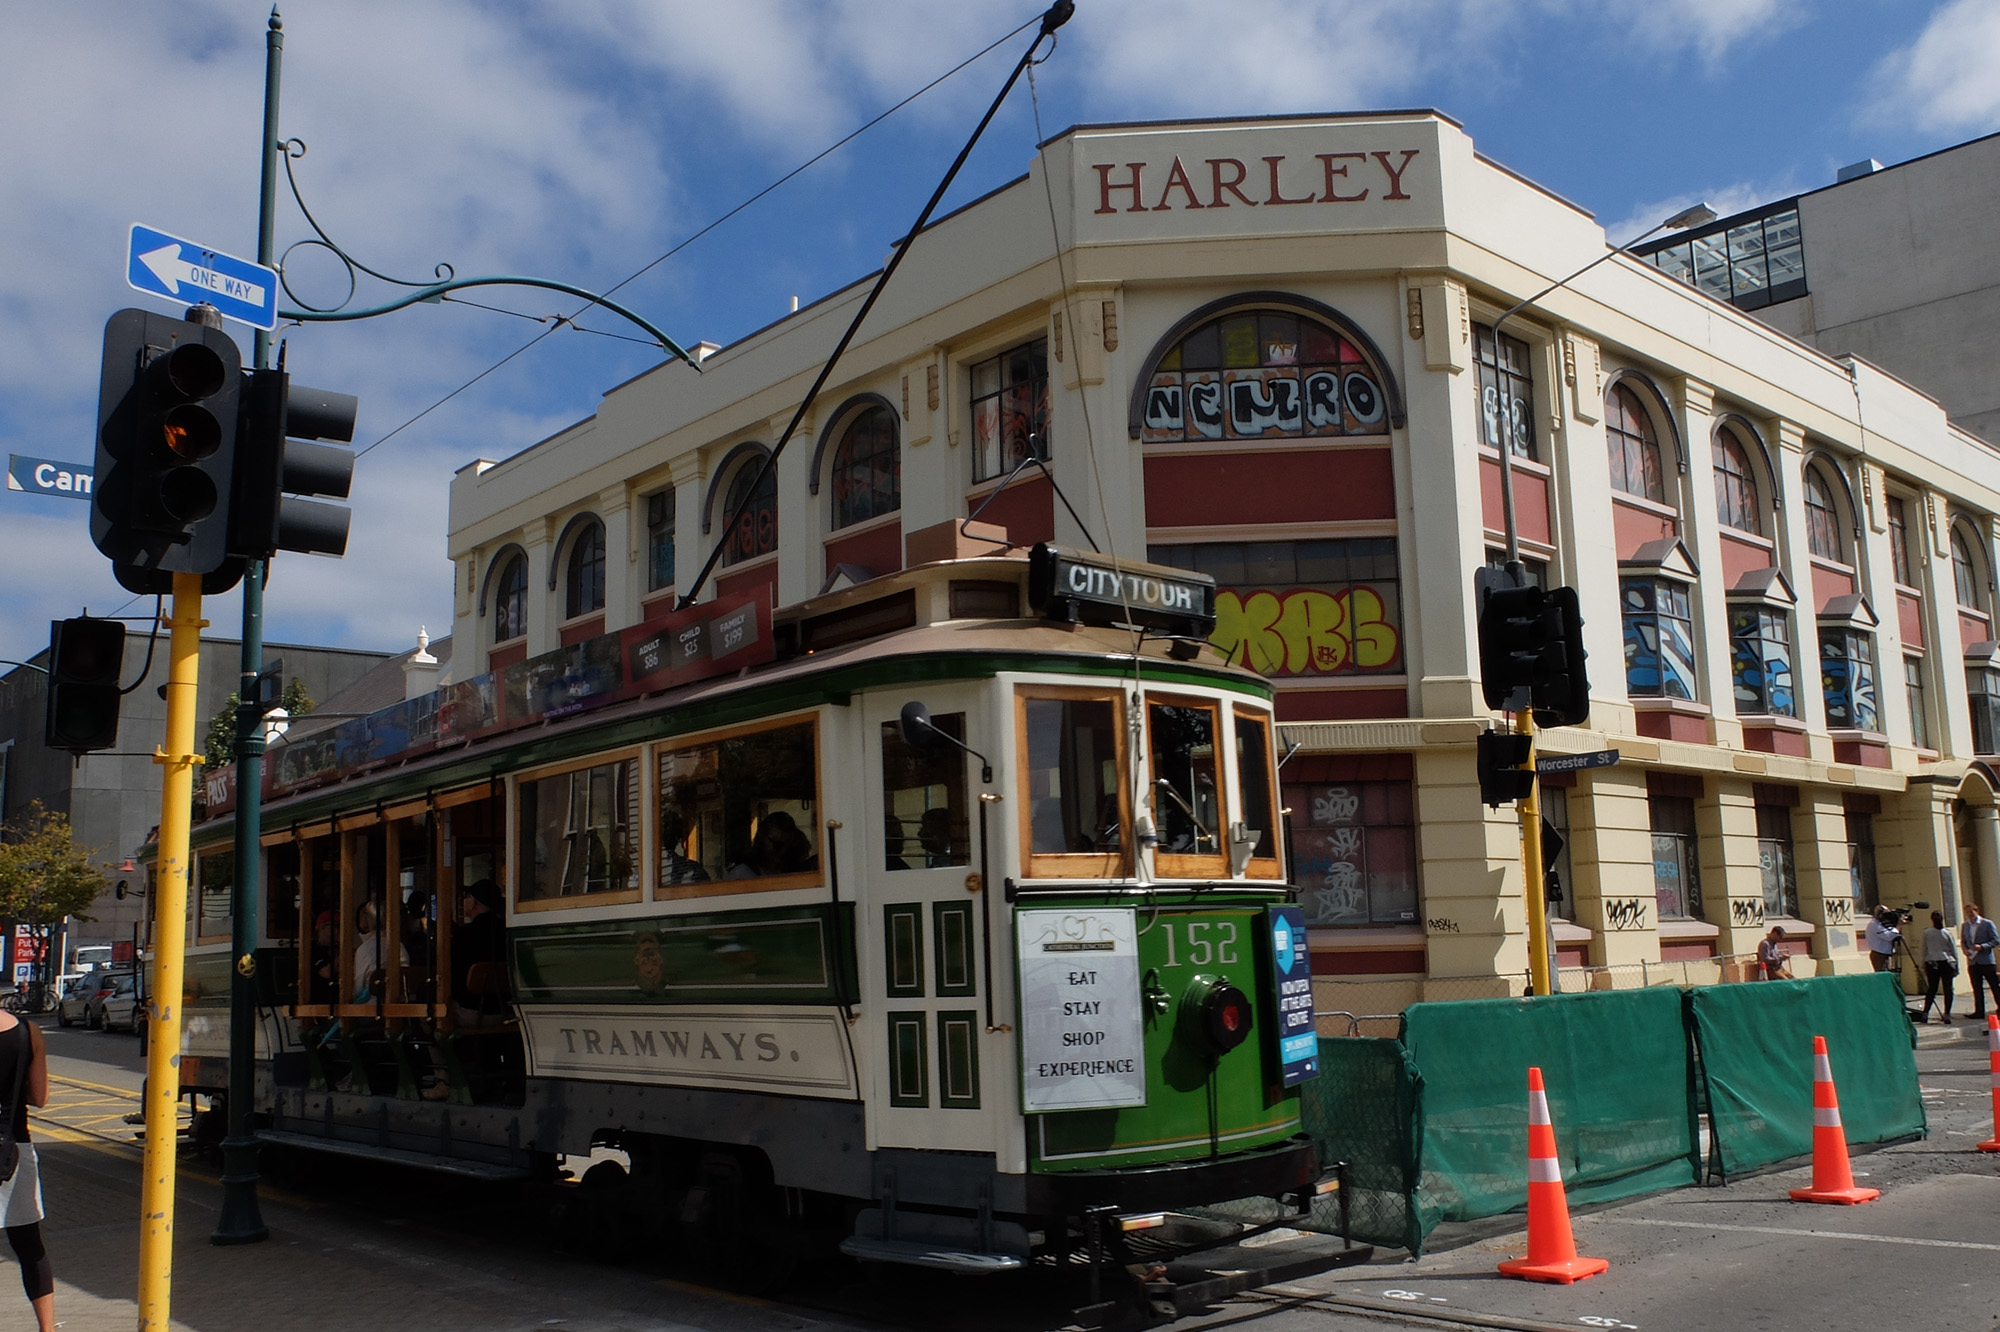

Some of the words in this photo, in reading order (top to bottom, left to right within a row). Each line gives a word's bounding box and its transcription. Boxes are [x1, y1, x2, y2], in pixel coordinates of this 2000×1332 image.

[1092, 149, 1420, 215] HARLEY
[190, 266, 218, 290] ONE
[224, 277, 252, 300] WAY
[34, 464, 94, 494] Cam
[1069, 564, 1123, 598] CITY
[1127, 575, 1192, 610] TOUR
[719, 613, 745, 633] FAMILY
[679, 626, 701, 643] CHILD
[724, 627, 743, 648] $199
[638, 638, 660, 656] ADULT
[684, 640, 698, 658] $25
[644, 652, 659, 671] $86
[1537, 756, 1589, 771] Worcester
[1597, 753, 1610, 765] St
[207, 776, 228, 807] PASS
[1161, 921, 1239, 968] 152
[1066, 970, 1098, 986] EAT
[1063, 1001, 1101, 1017] STAY
[559, 1028, 801, 1063] TRAMWAYS.
[1062, 1031, 1105, 1048] SHOP
[1036, 1058, 1135, 1078] EXPERIENCE
